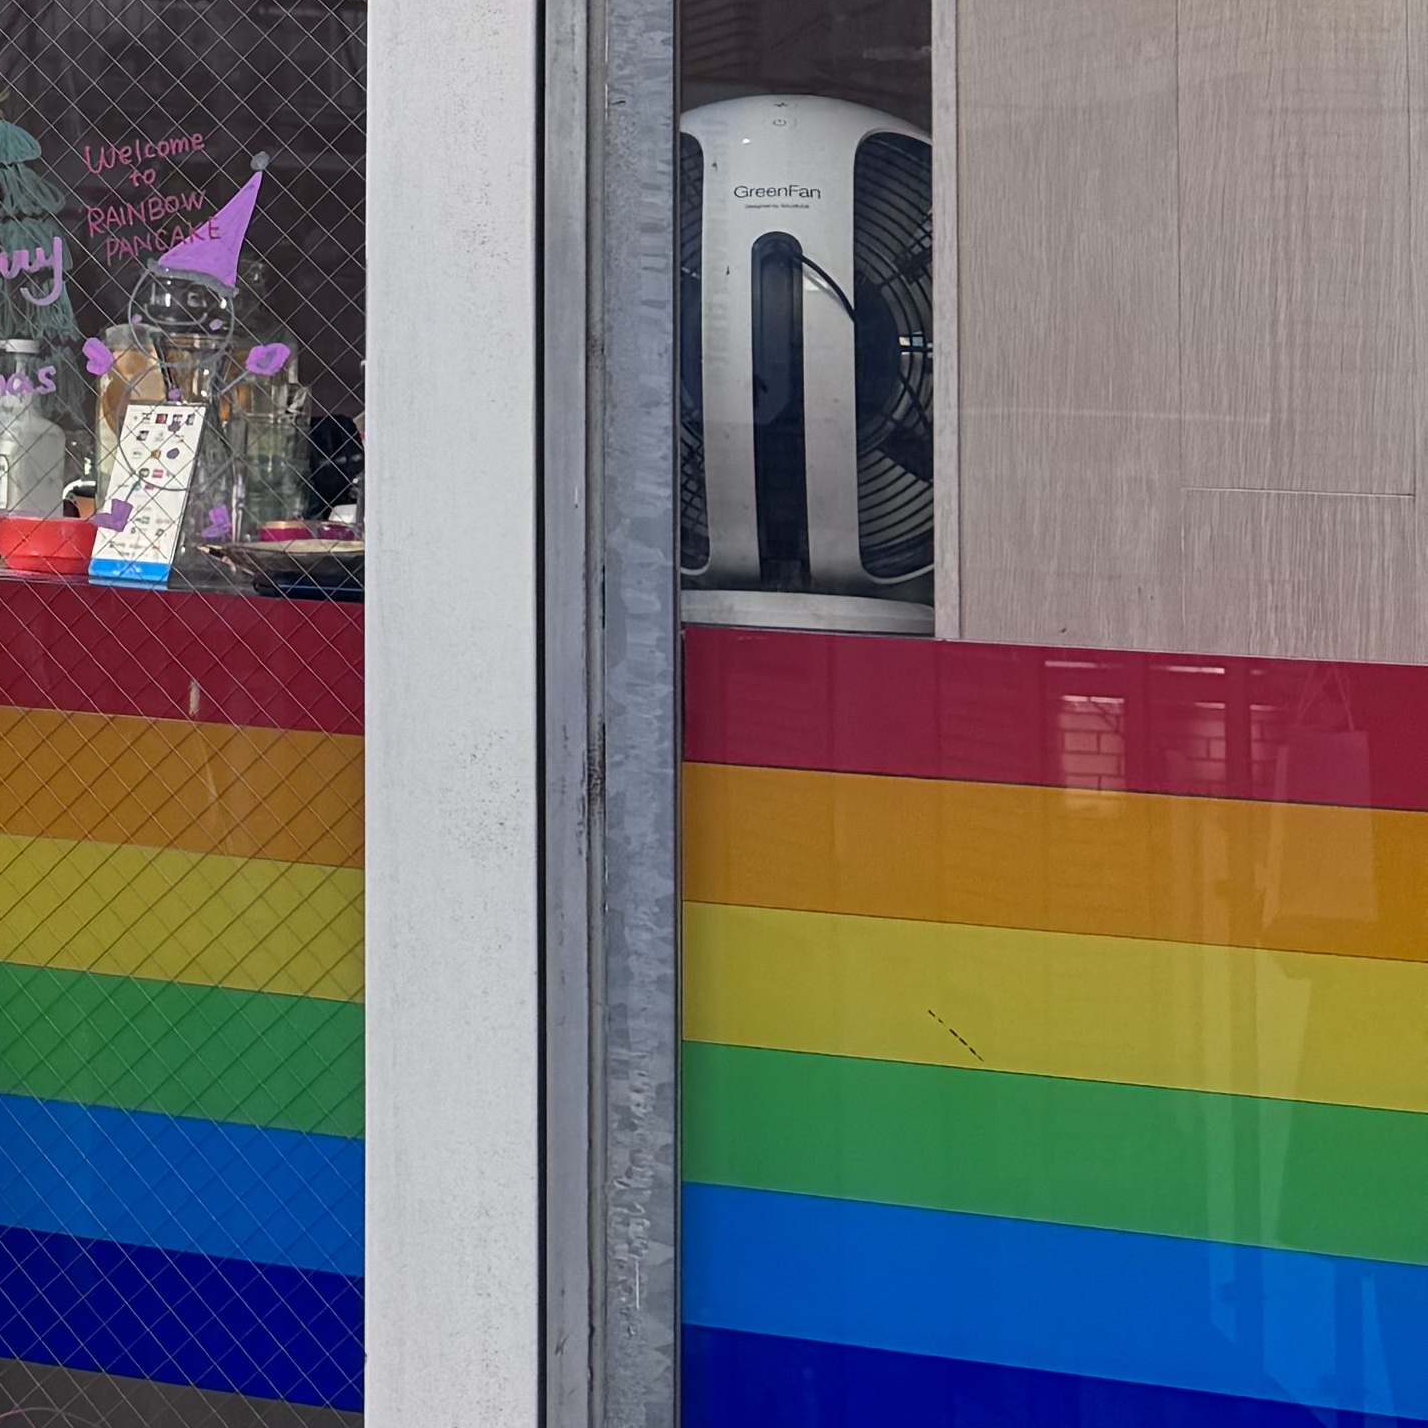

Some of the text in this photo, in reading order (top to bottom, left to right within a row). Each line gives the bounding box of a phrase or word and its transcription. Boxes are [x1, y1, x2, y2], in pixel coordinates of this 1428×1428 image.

[84, 133, 205, 174] Welcome
[129, 168, 156, 188] to
[733, 184, 821, 199] GreenFan
[87, 190, 206, 239] RAINBOW
[105, 215, 222, 266] PANCAKE
